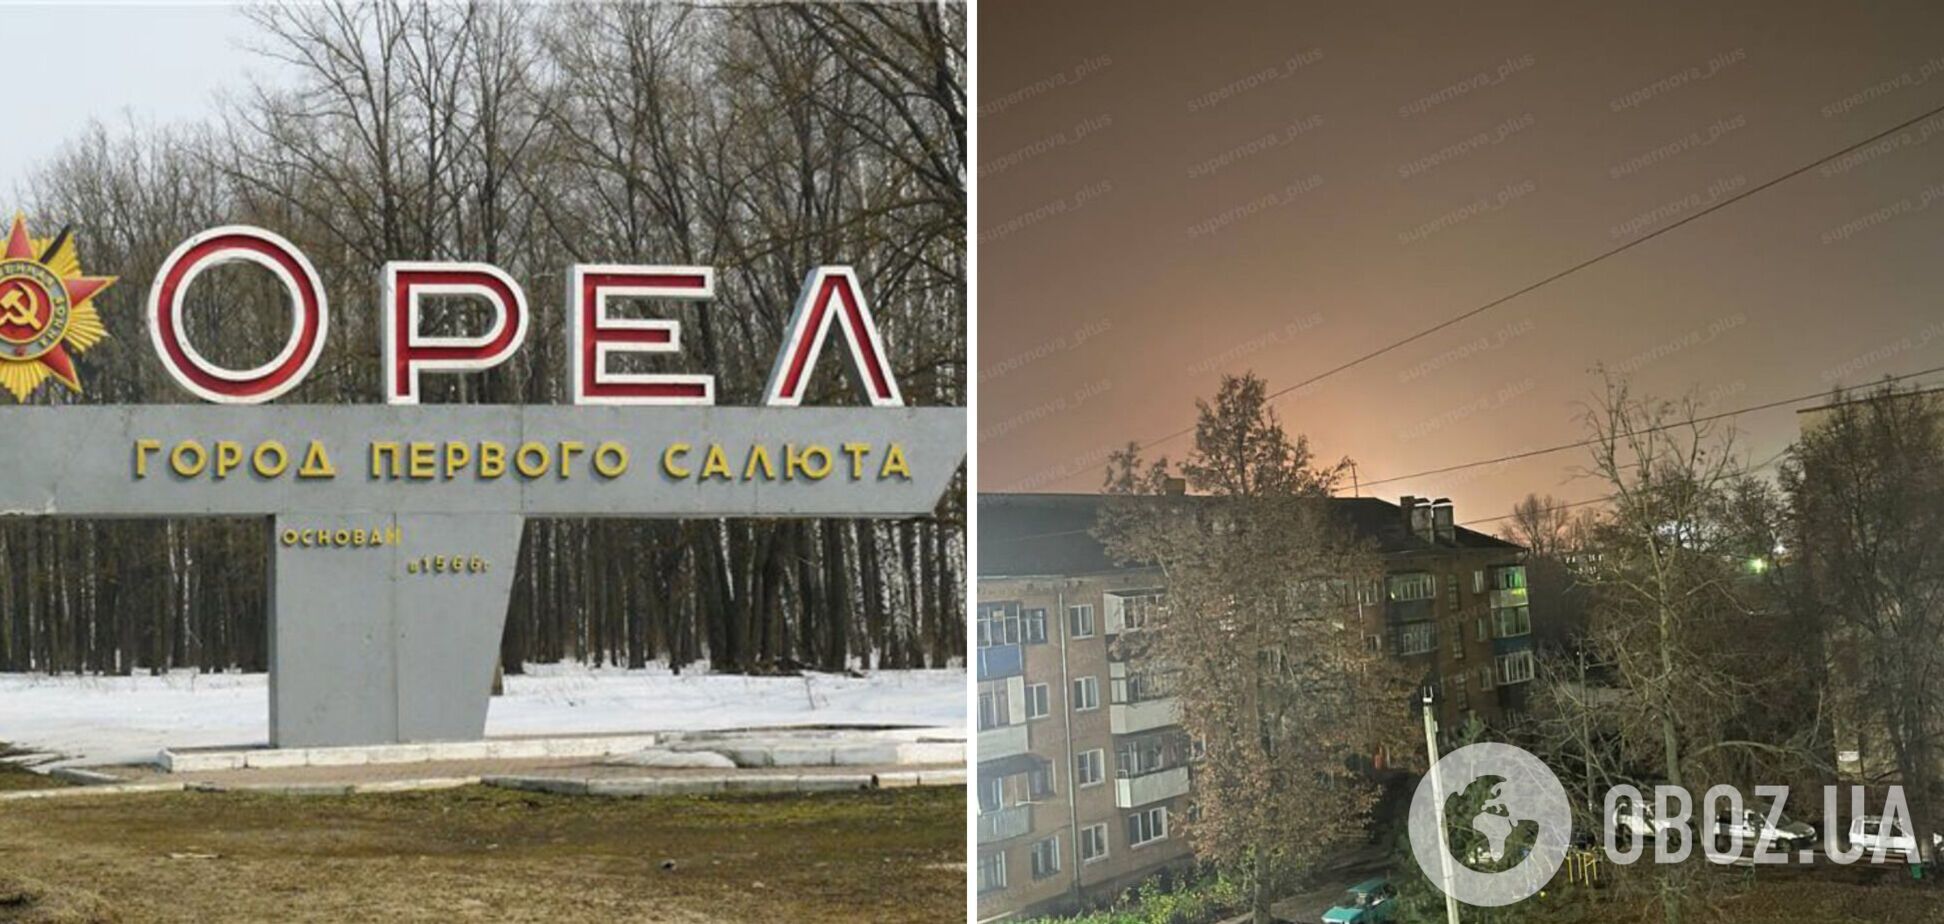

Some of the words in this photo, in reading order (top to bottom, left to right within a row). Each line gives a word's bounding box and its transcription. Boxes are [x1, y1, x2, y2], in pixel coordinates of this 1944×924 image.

[147, 225, 905, 405] ОРЕЛ
[134, 438, 335, 479] ГОРОД
[369, 440, 630, 480] ПЕРВОГО
[662, 441, 912, 480] САЛЮТА
[281, 524, 403, 547] ОСНОВАН
